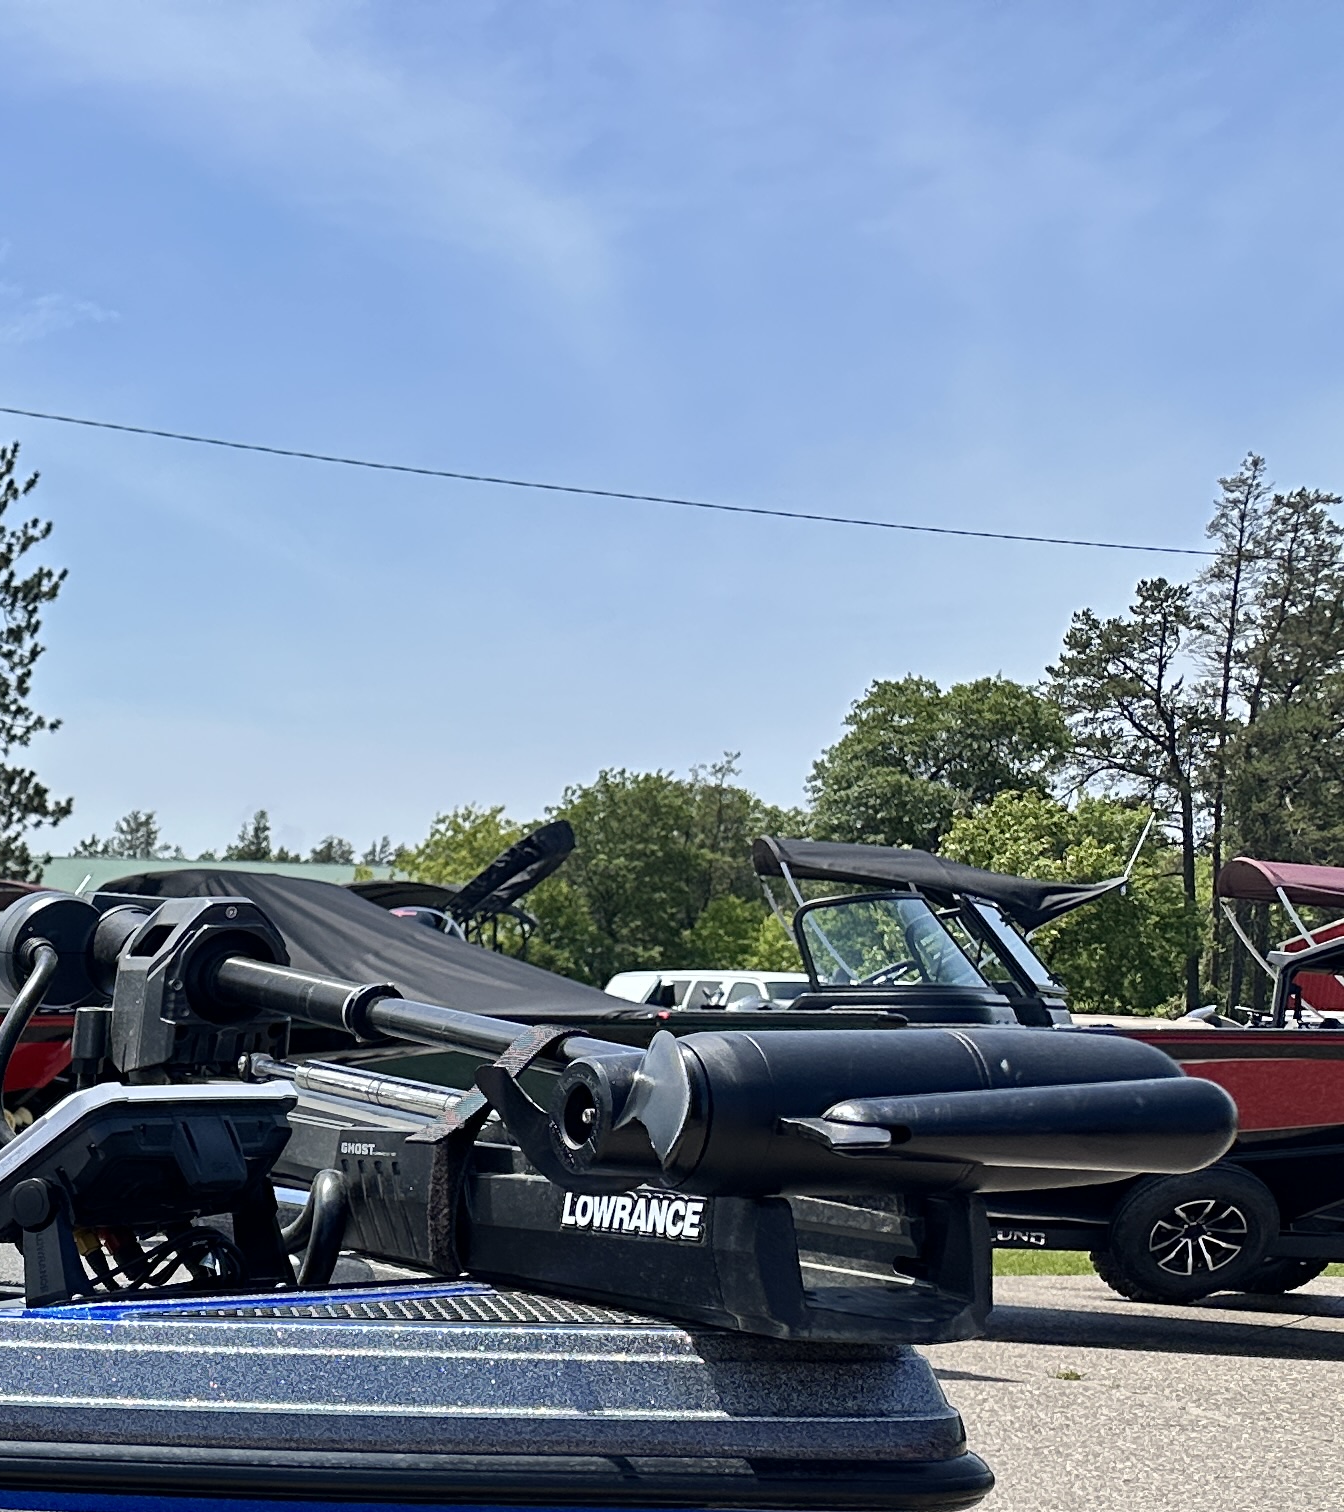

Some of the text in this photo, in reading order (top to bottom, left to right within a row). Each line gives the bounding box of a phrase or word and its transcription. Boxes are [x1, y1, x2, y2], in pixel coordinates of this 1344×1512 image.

[340, 1142, 376, 1156] GHOST
[561, 1191, 704, 1239] LOWRANCE
[991, 1229, 1046, 1246] UND
